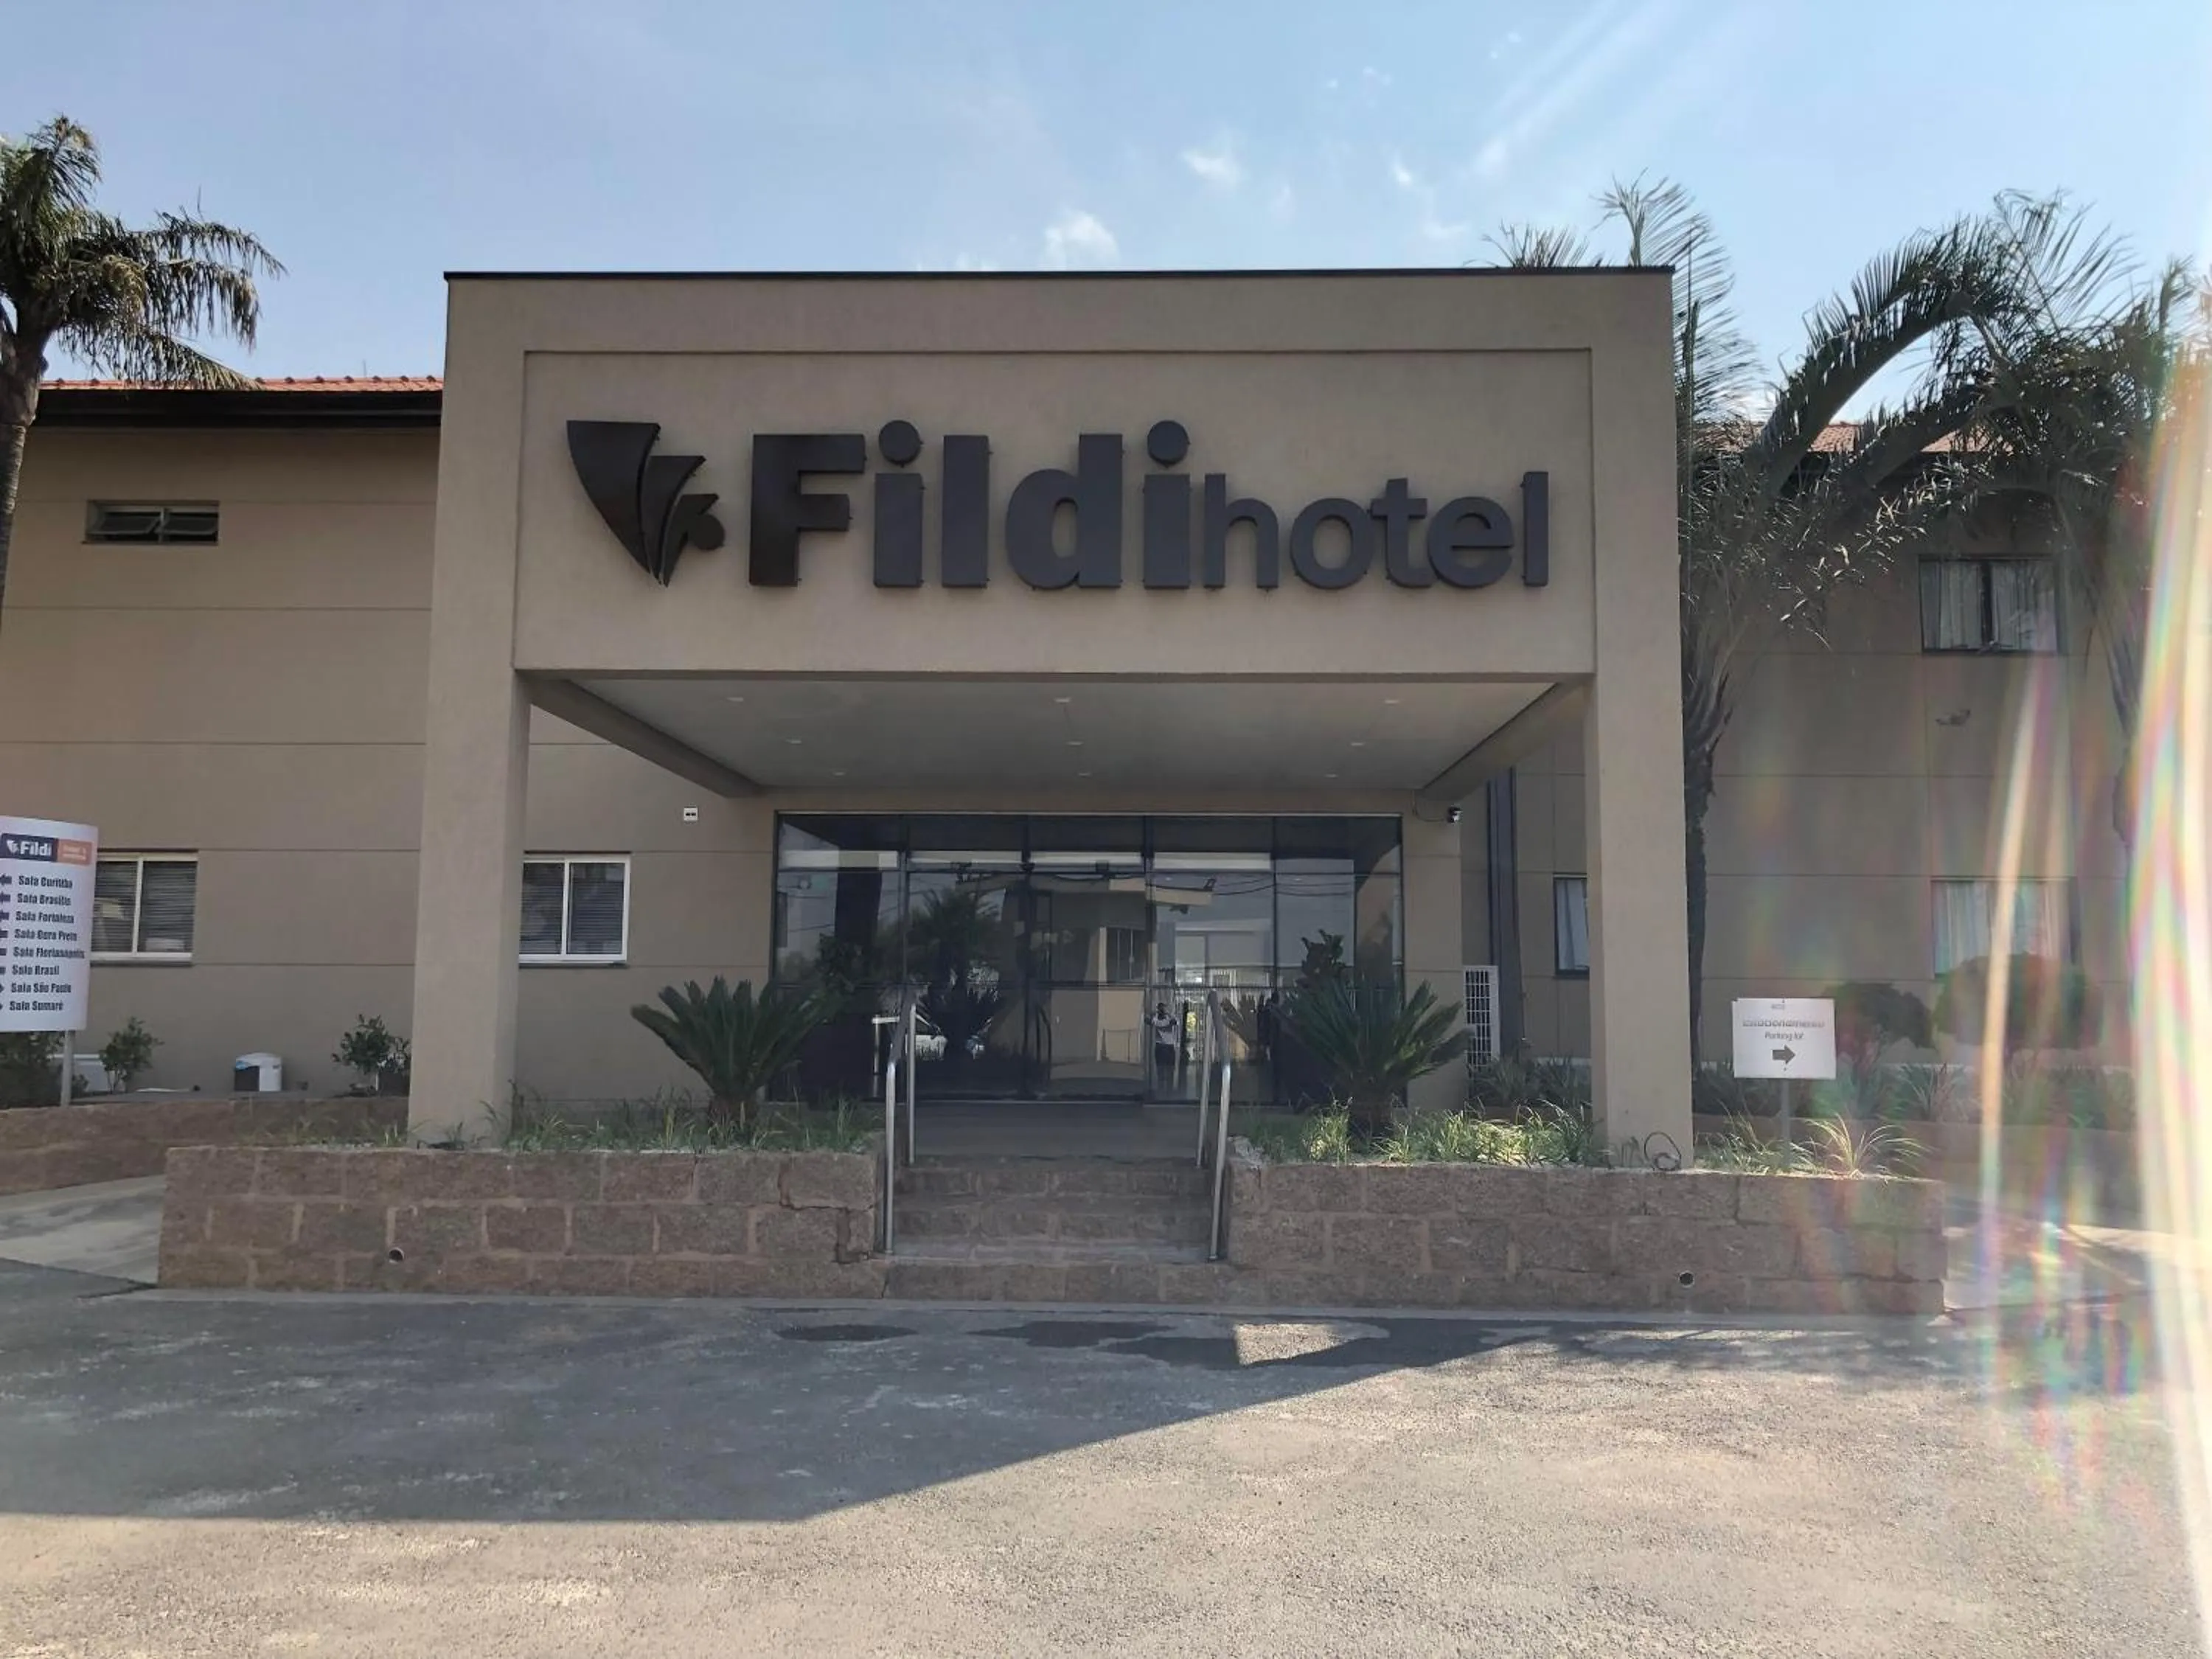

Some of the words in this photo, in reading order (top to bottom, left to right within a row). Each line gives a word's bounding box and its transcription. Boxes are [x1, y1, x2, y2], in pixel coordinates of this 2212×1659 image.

[20, 841, 52, 856] Fildi
[18, 875, 39, 886] Sala
[17, 893, 38, 904] Sala
[15, 911, 36, 921] Sala
[15, 929, 35, 939] Sala
[13, 947, 35, 957] Sala
[36, 947, 85, 959] Florian
[12, 964, 33, 975] Sala
[11, 982, 32, 993] Sala
[10, 1001, 30, 1011] Sala
[1764, 1032, 1793, 1041] Parking
